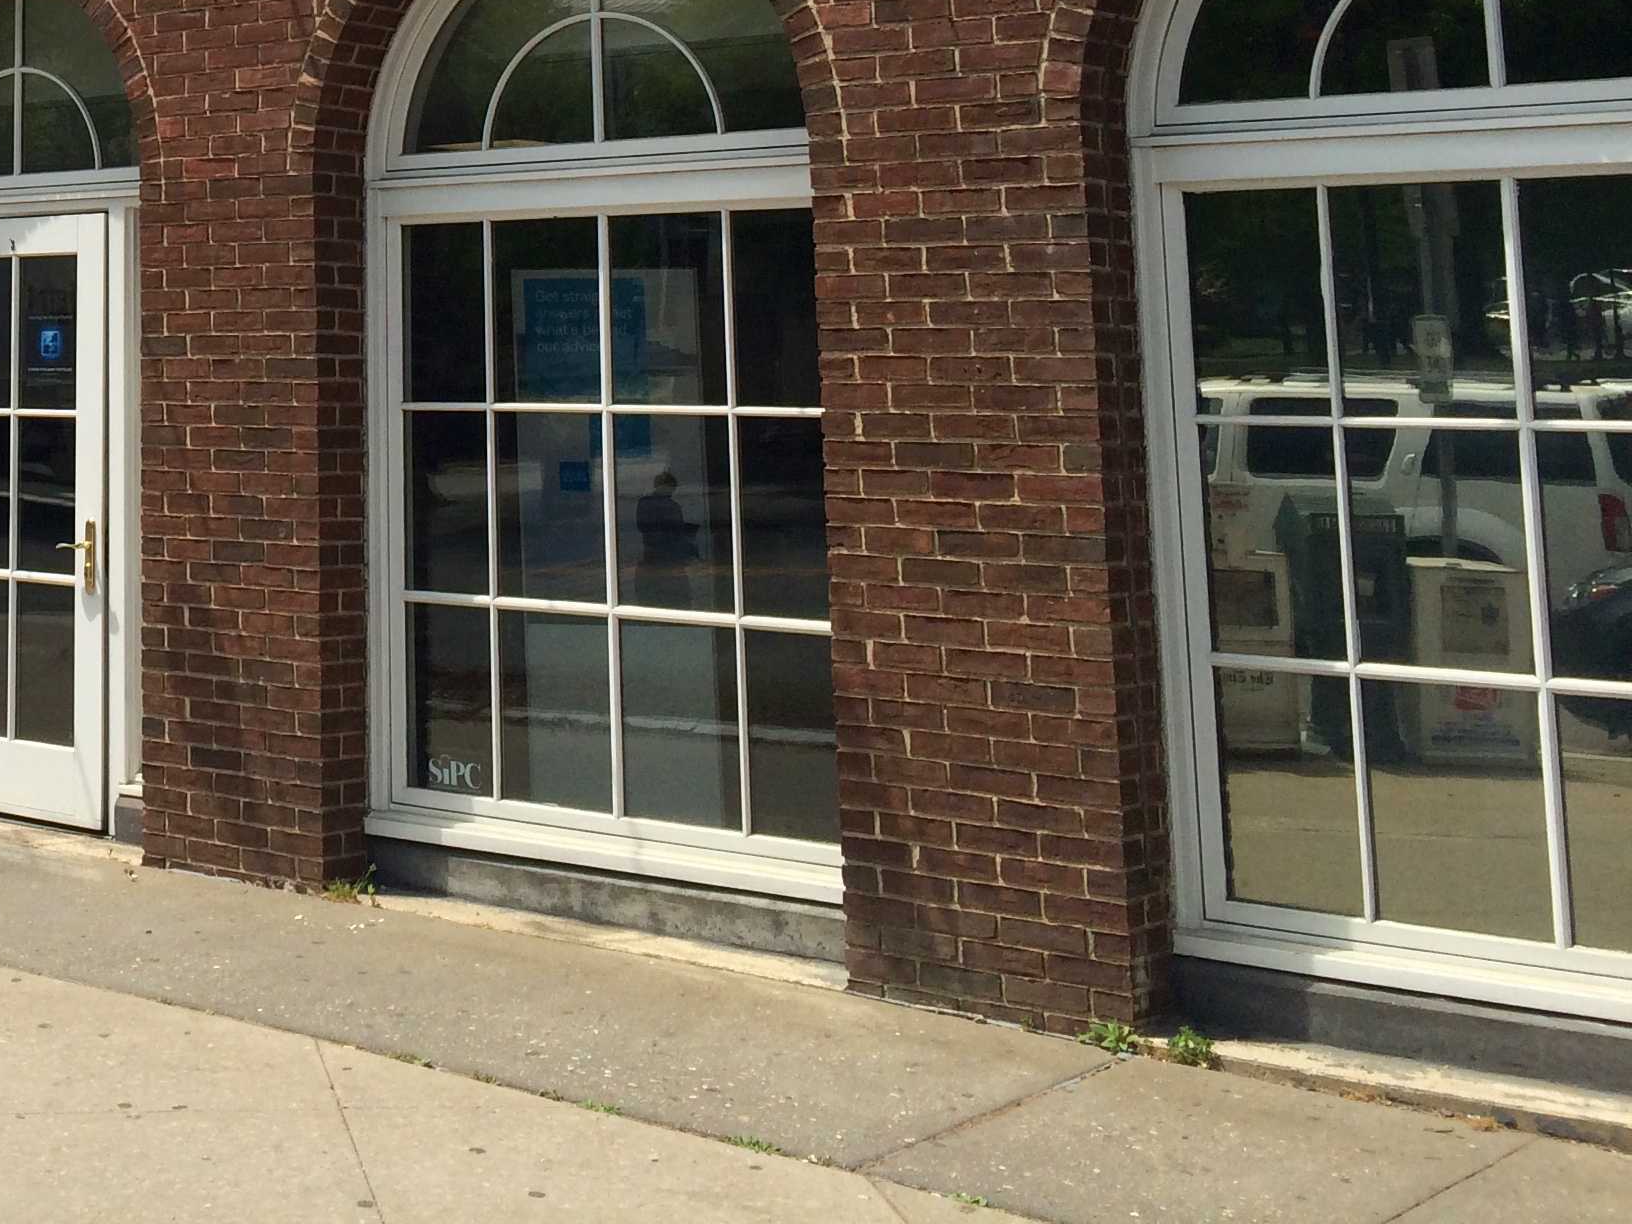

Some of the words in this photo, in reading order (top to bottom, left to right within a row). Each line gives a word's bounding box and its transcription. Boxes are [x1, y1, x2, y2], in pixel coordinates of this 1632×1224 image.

[535, 288, 559, 303] Get
[562, 289, 599, 306] straig
[536, 342, 559, 352] our
